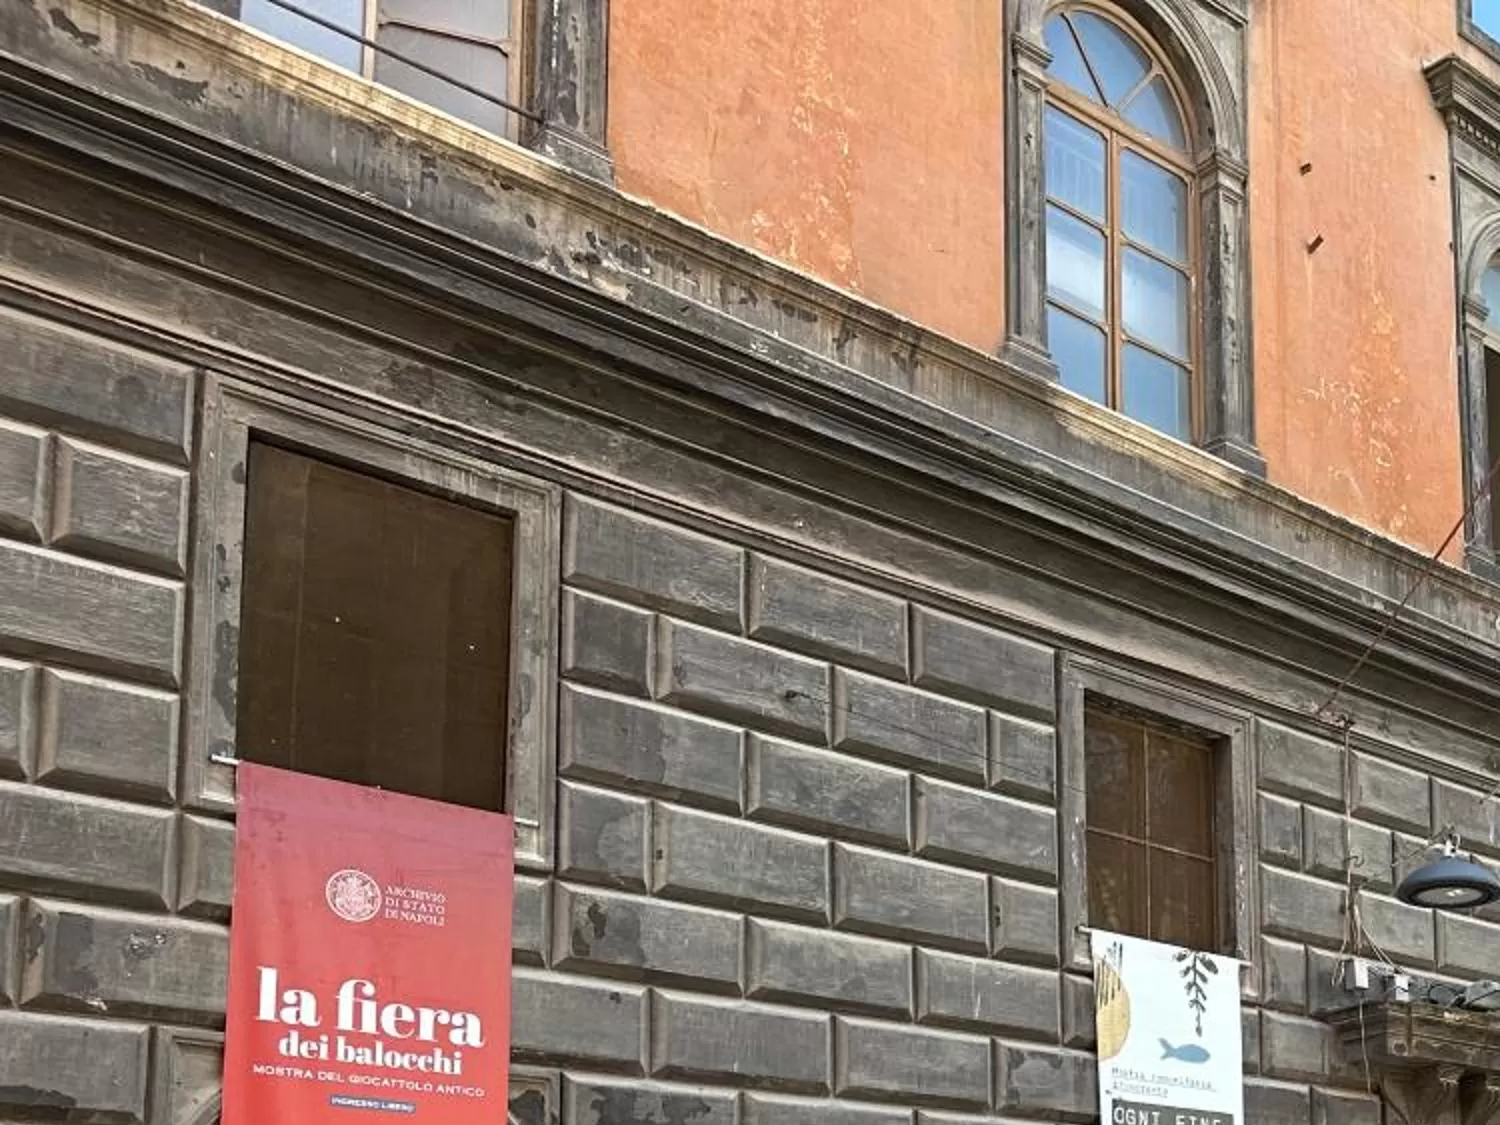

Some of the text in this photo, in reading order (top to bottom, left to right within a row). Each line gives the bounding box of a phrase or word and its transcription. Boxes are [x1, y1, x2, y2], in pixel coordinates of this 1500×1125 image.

[385, 897, 445, 915] DI STATO
[254, 966, 486, 1048] la fiera
[278, 1030, 462, 1075] dei balocchi
[253, 1064, 485, 1097] MOSTRA DEL GIOCATTOLO ANTICO
